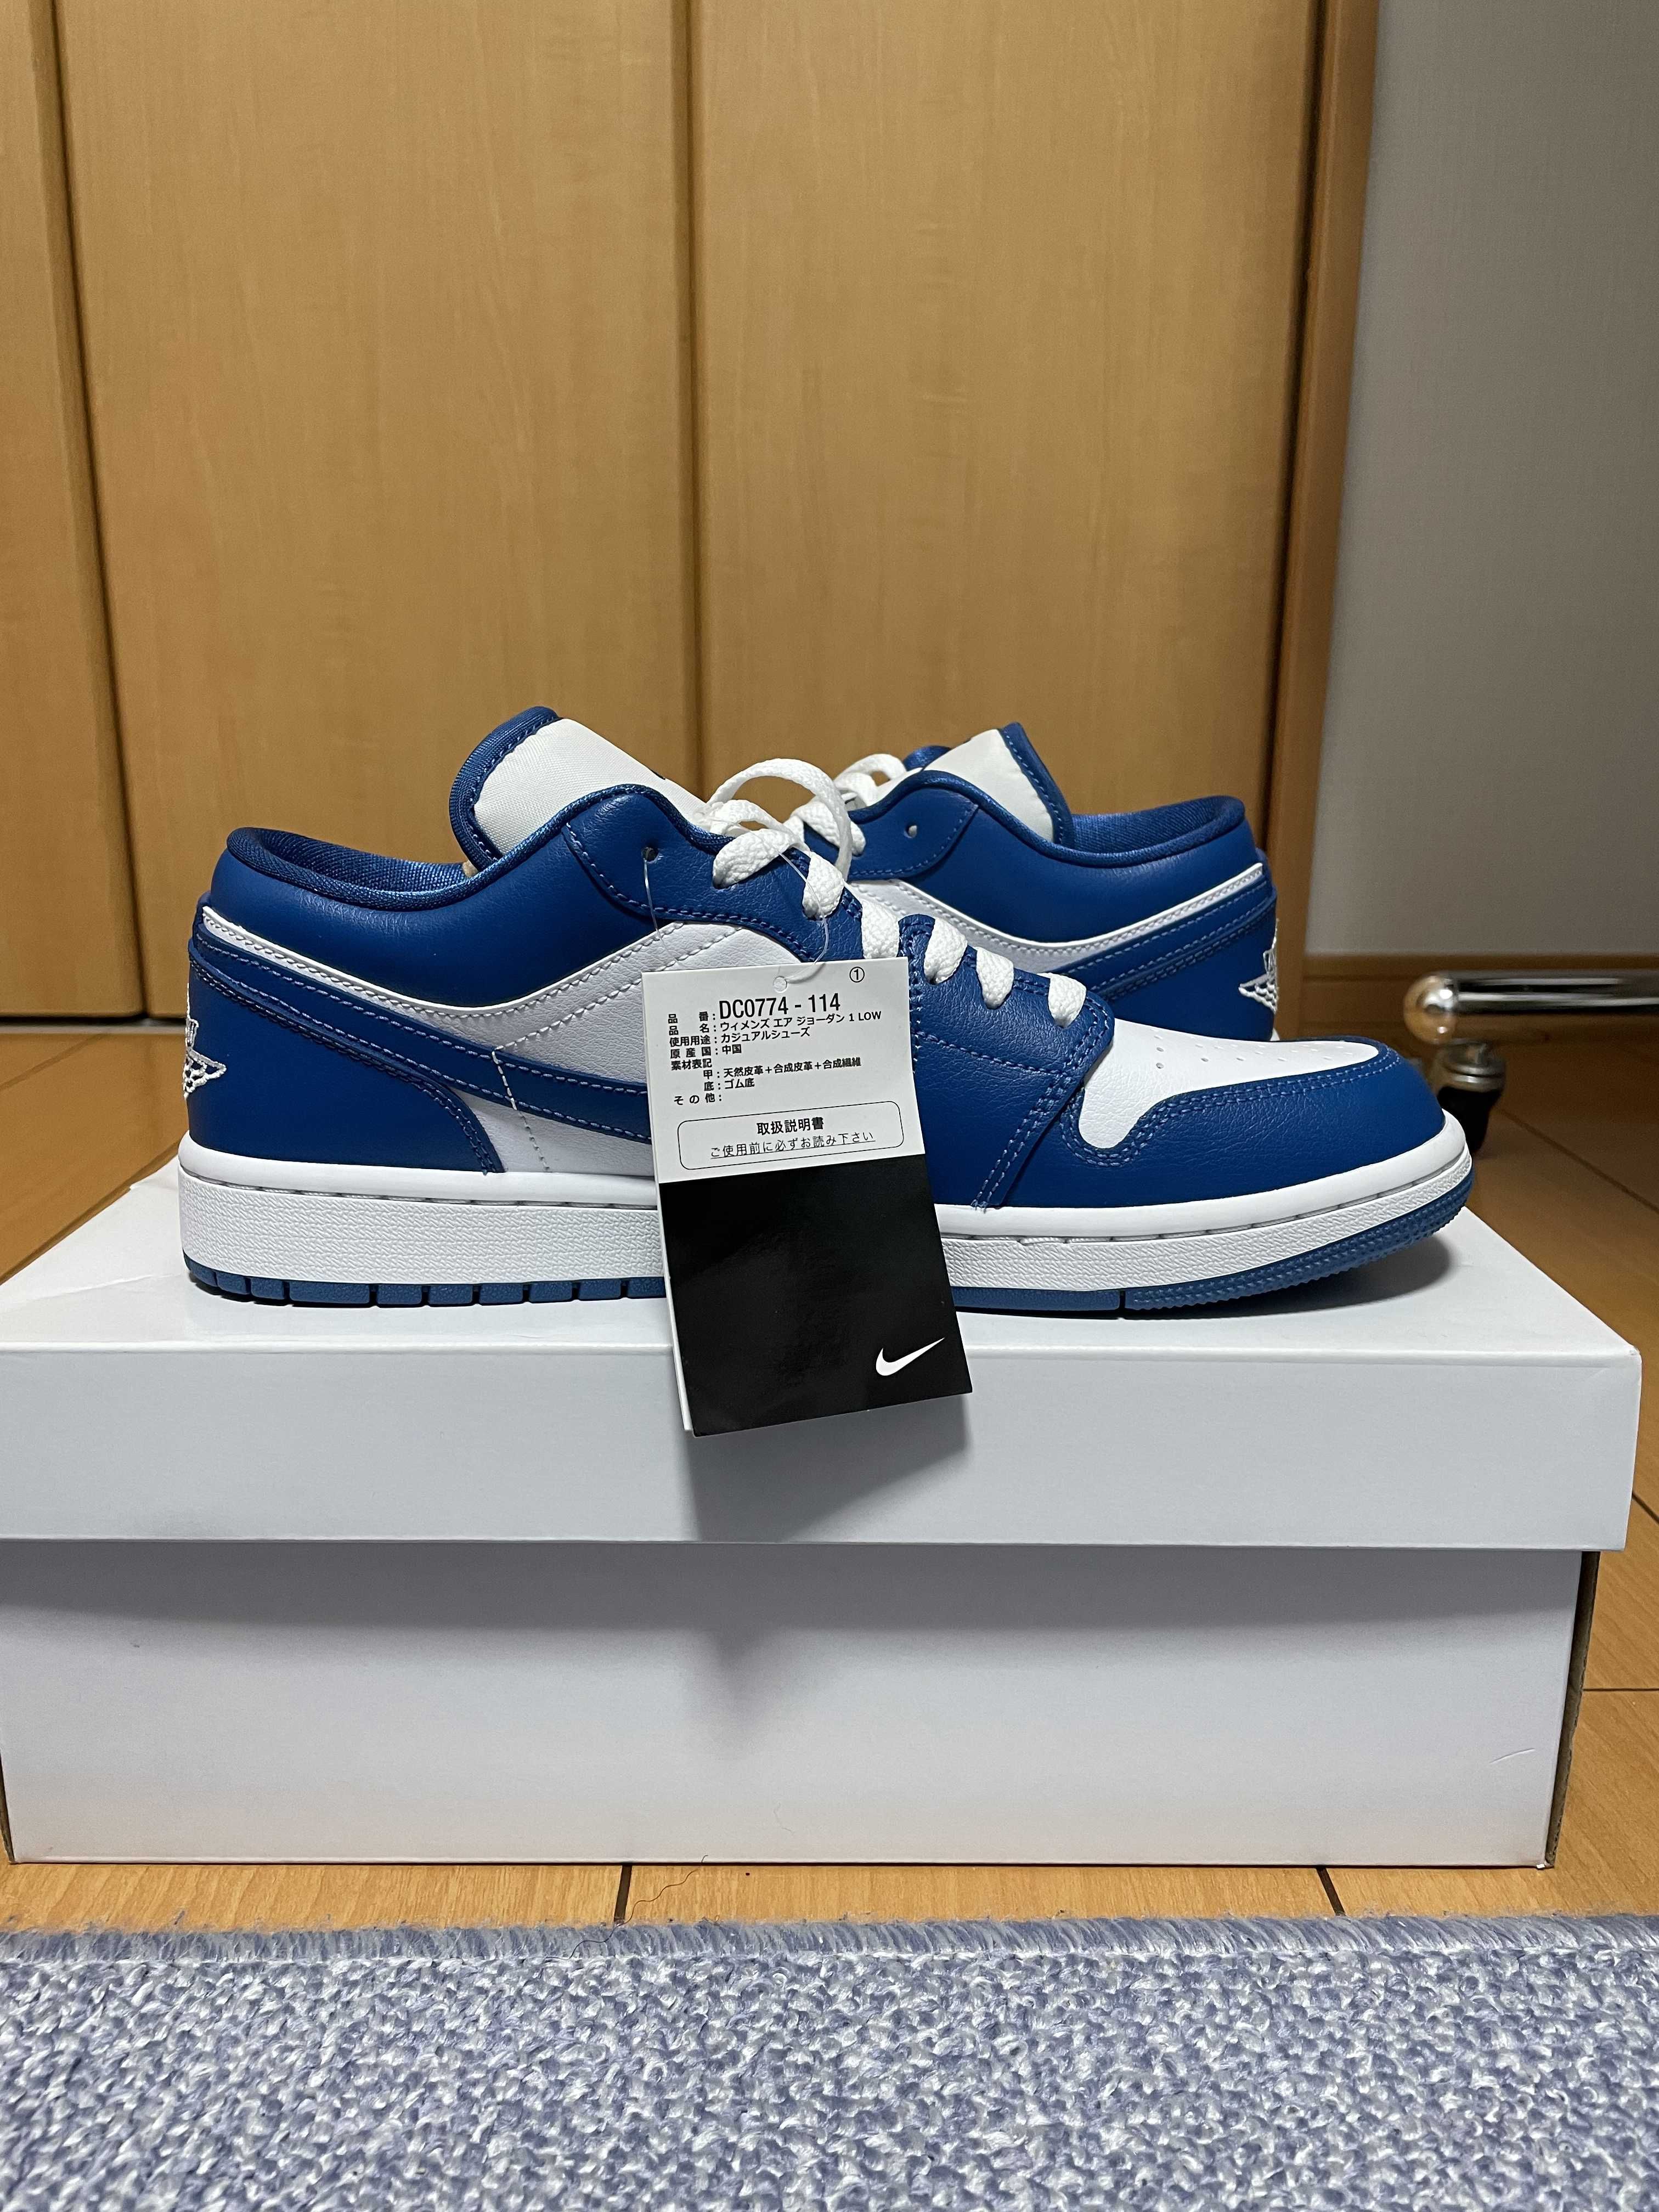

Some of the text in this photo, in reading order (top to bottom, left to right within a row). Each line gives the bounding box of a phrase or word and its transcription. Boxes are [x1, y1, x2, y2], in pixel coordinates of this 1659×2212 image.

[719, 996, 789, 1019] DC0774
[808, 993, 840, 1013] 114
[720, 1018, 770, 1032] ウィメンズ
[774, 1017, 793, 1028] エア
[797, 1013, 845, 1026] ジョーダン
[849, 1013, 855, 1022] 1
[858, 1011, 882, 1021] LOW
[722, 1043, 742, 1054] 中国
[671, 1058, 712, 1071] 素材表記
[724, 1077, 755, 1090] ゴム底
[757, 1116, 825, 1136] 取扱説明書
[710, 1131, 874, 1158] ご使用前に必ずお読み下さい
